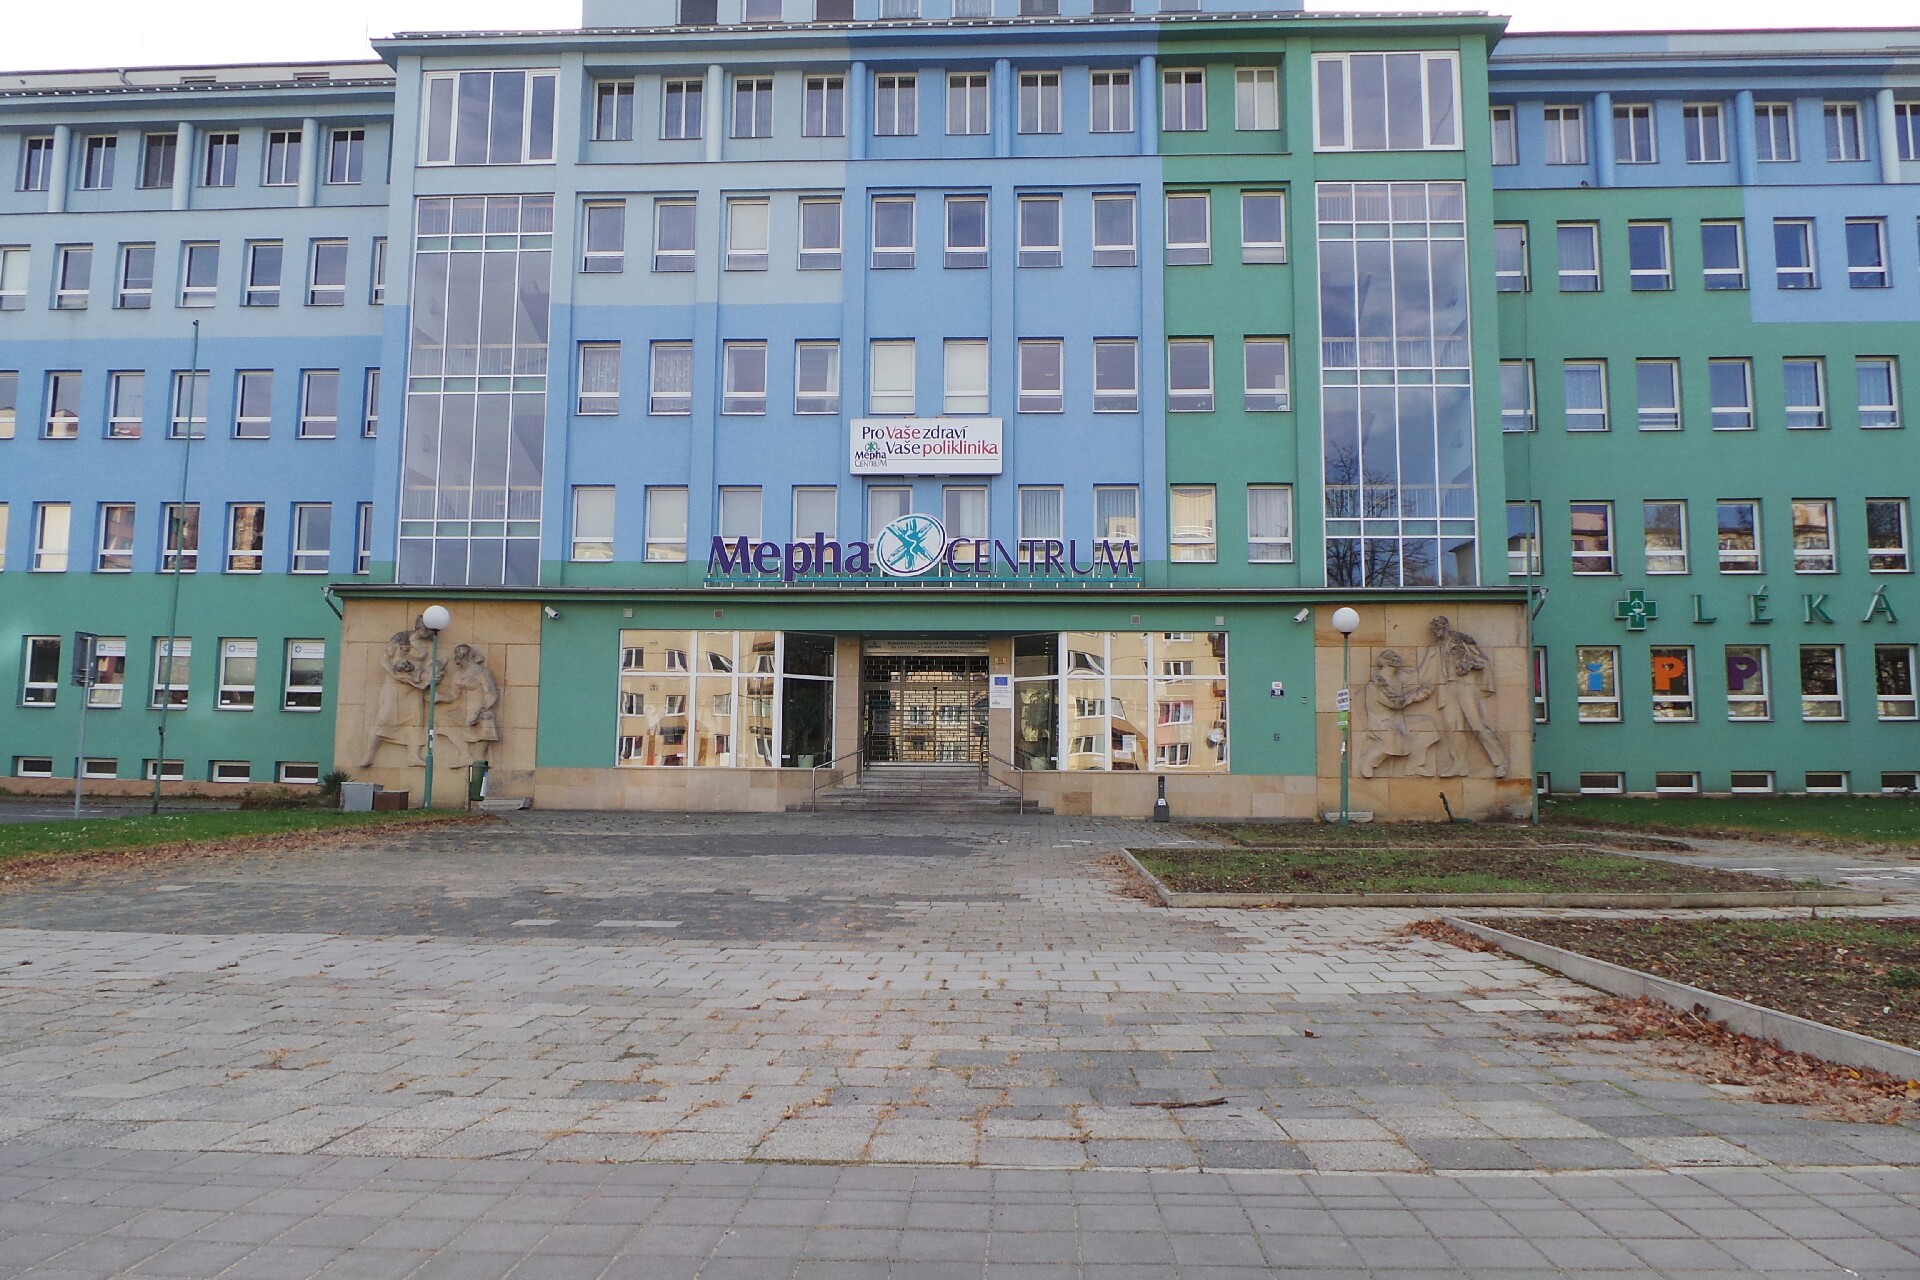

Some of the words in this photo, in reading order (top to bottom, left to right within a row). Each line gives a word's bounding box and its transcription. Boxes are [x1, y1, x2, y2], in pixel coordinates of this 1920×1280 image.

[862, 426, 885, 440] Pro
[886, 424, 921, 440] Vaše
[922, 424, 969, 440] zdraví
[854, 450, 886, 460] Mepha
[885, 440, 921, 454] Vaše
[922, 440, 998, 458] poliklinika
[854, 459, 888, 467] CENTRUM
[707, 532, 872, 582] Mepha
[946, 537, 1135, 575] CENTRUM
[1691, 585, 1898, 624] LÉKÁ
